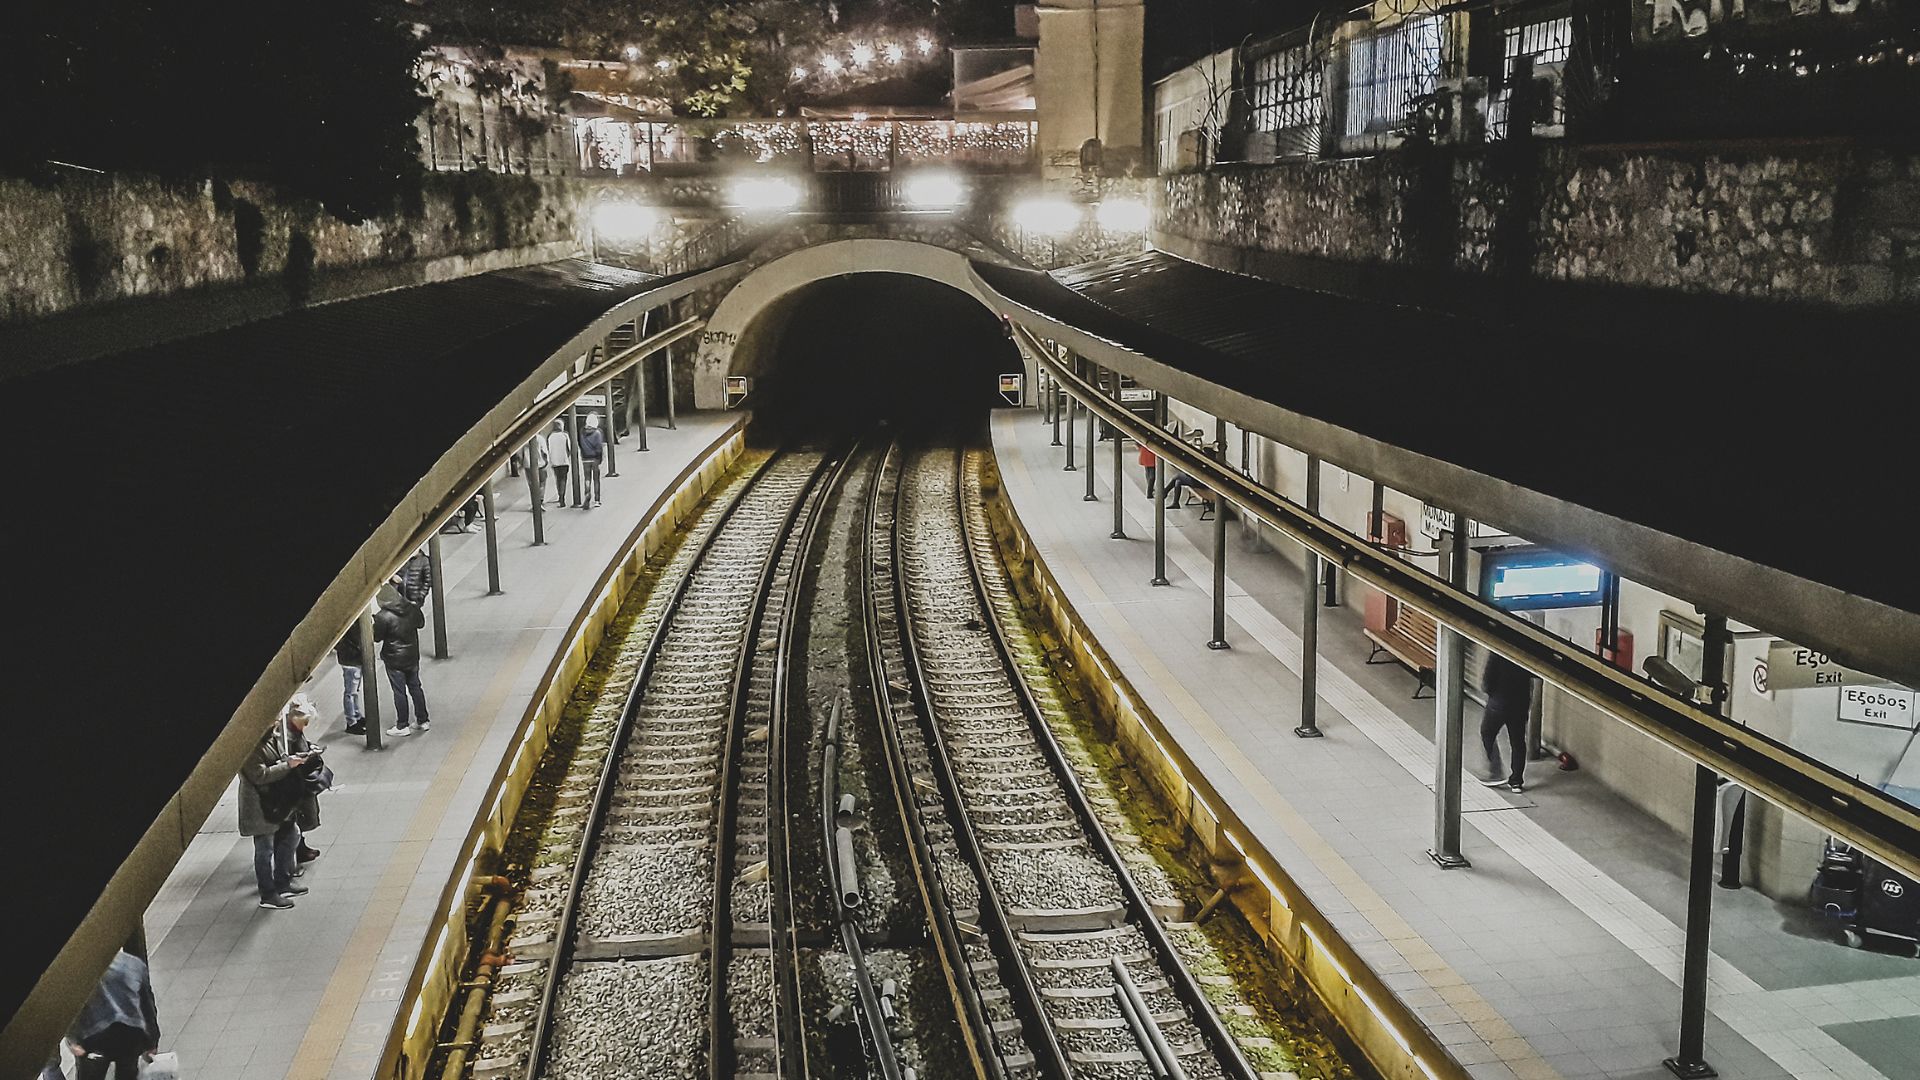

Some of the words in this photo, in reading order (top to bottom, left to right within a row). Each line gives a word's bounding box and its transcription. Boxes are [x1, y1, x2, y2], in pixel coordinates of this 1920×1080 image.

[1793, 650, 1829, 669] Έξο
[1815, 671, 1842, 684] Exit
[1844, 690, 1907, 710] Έξοδος
[1864, 708, 1887, 719] Exit
[371, 953, 409, 999] THE
